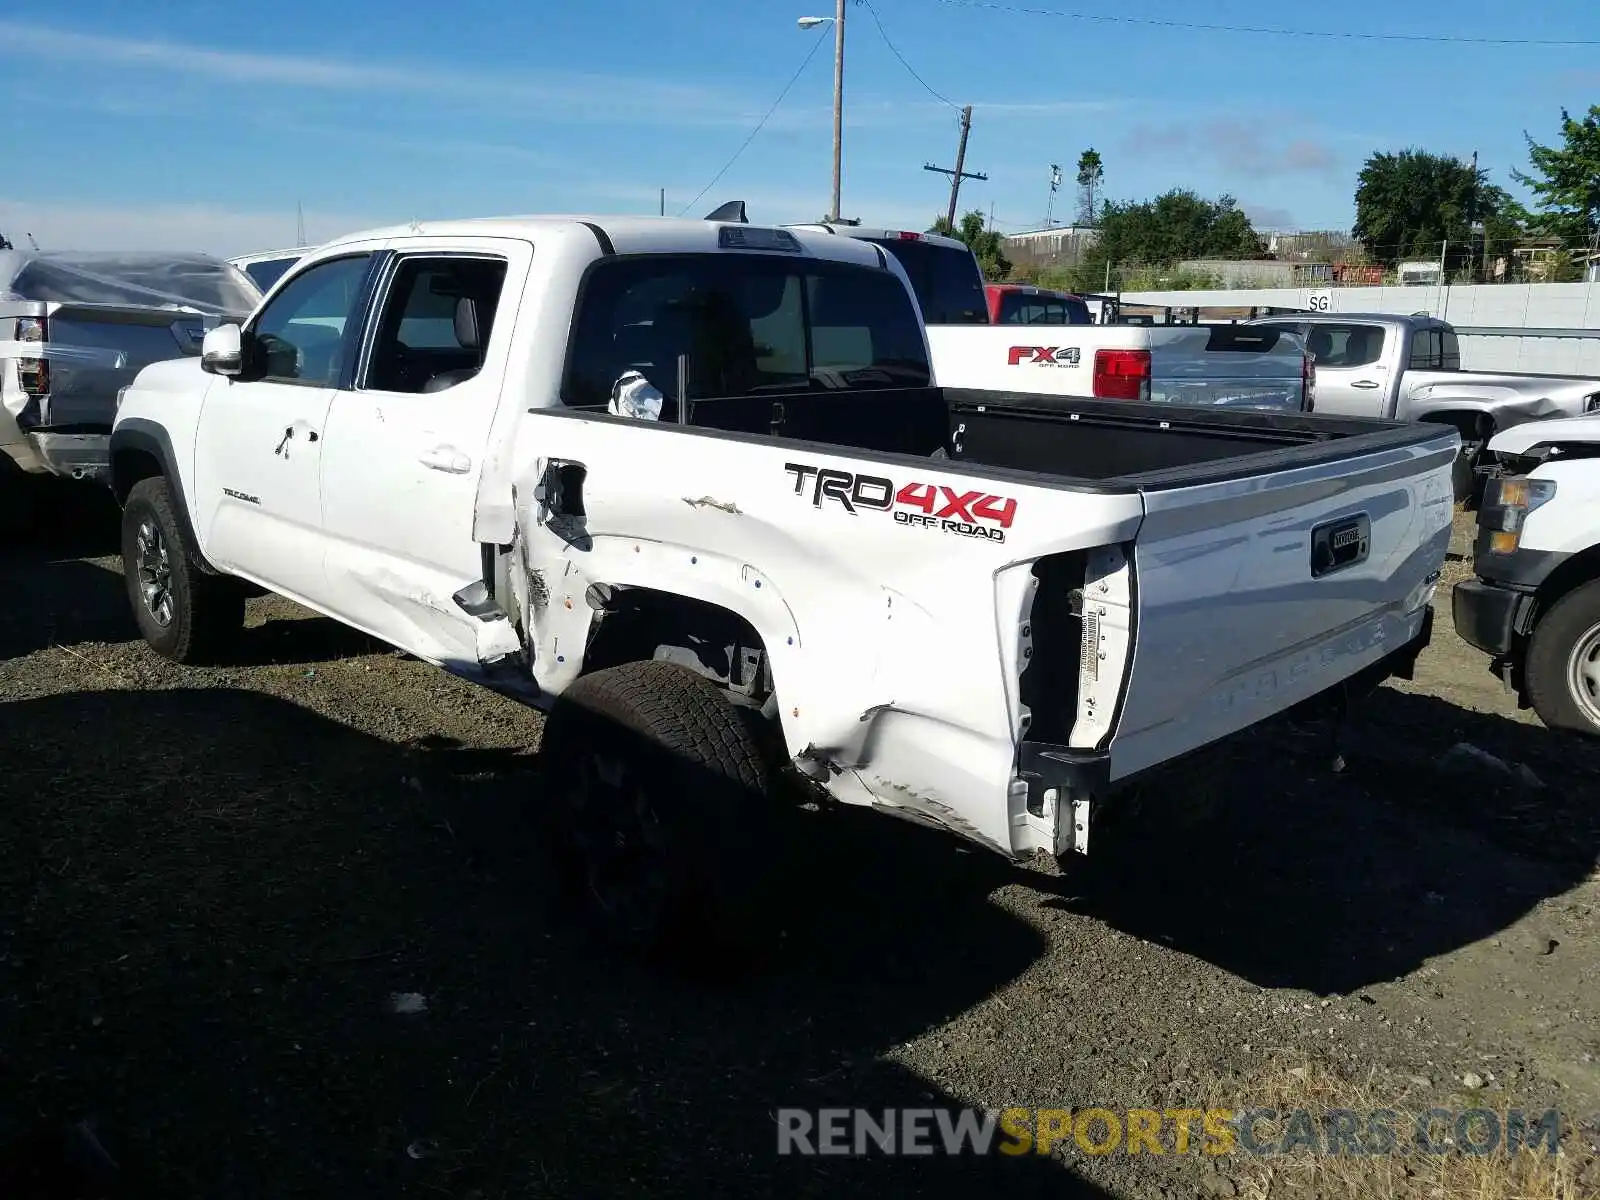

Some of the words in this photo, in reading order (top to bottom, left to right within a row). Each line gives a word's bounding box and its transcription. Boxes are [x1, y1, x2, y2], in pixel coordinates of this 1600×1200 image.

[1309, 296, 1328, 311] SG
[1008, 346, 1081, 365] FX4
[893, 511, 939, 529] OFF
[941, 519, 1005, 544] ROAD
